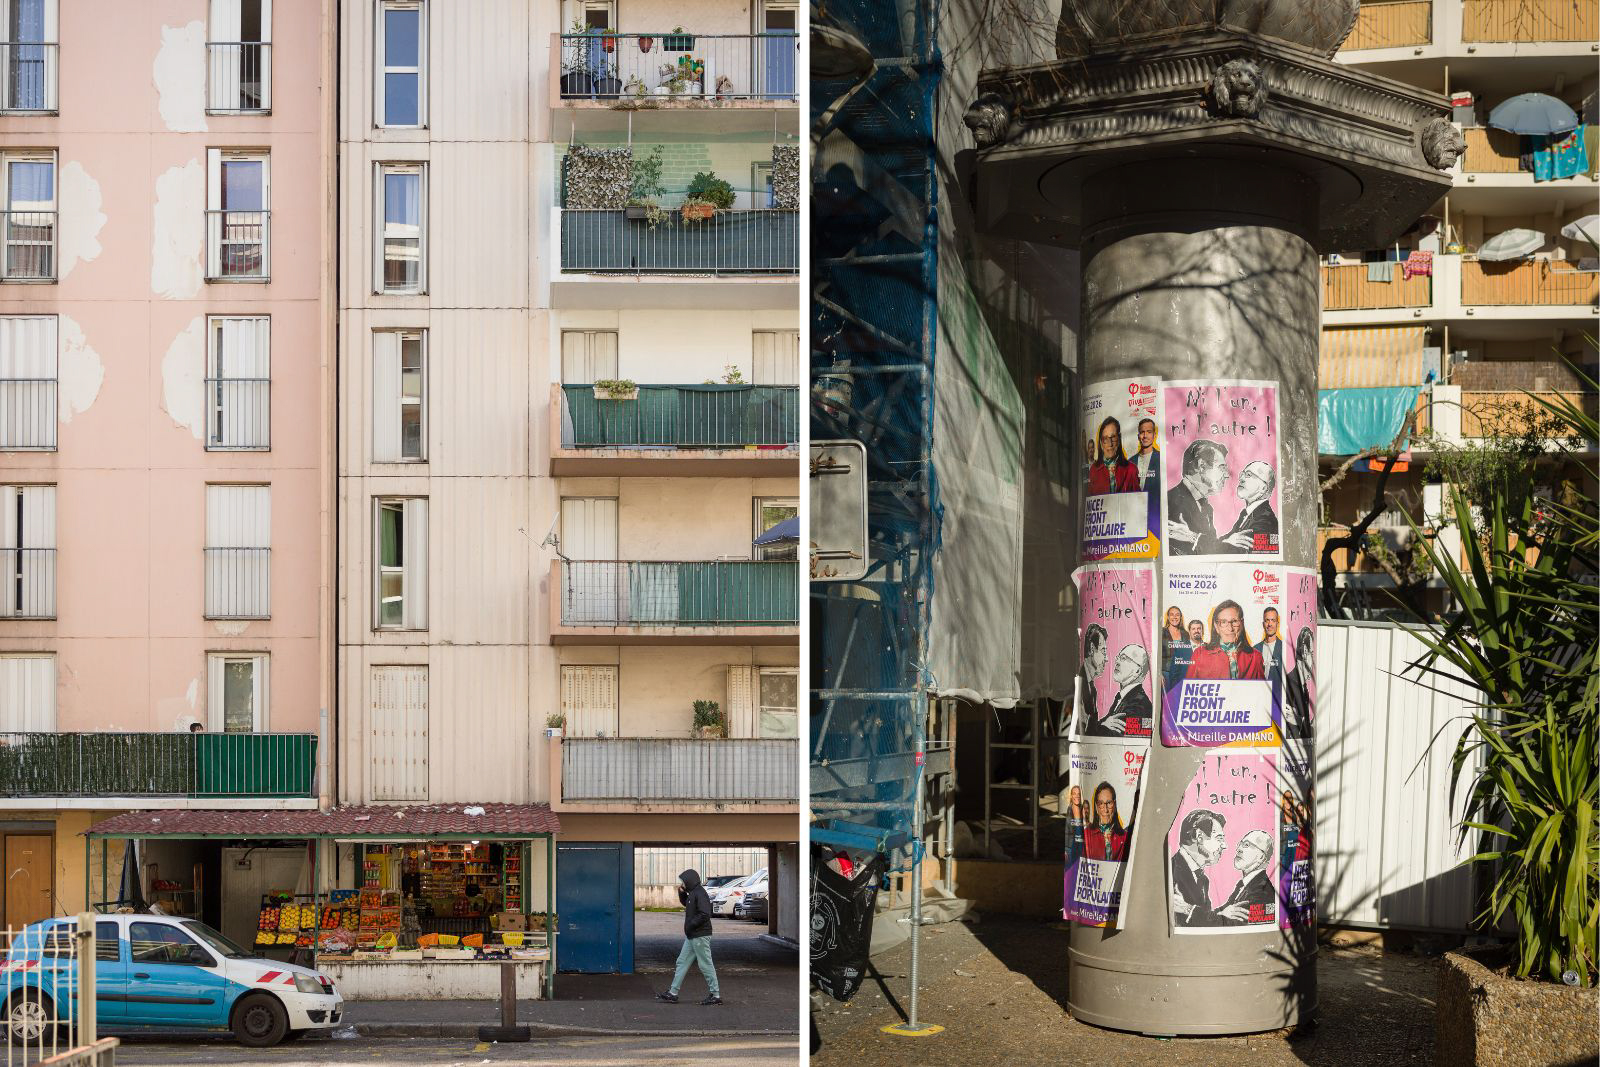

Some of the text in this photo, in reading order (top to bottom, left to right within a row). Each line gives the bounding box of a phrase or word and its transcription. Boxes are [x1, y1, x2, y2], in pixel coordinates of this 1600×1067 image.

[1186, 387, 1206, 409] Ni
[1171, 419, 1186, 437] ni
[1085, 511, 1107, 525] FRONT
[1084, 522, 1126, 538] POPULAIRE
[1108, 543, 1150, 554] DAMIANO
[1169, 580, 1218, 589] Nice 2026
[1182, 697, 1226, 709] FRONT
[1180, 710, 1251, 723] POPULAIRE
[1187, 732, 1227, 742] Mireille
[1228, 732, 1274, 742] DAMIANO
[1078, 873, 1103, 890] FRONT
[1076, 886, 1121, 905] POPULAIRE
